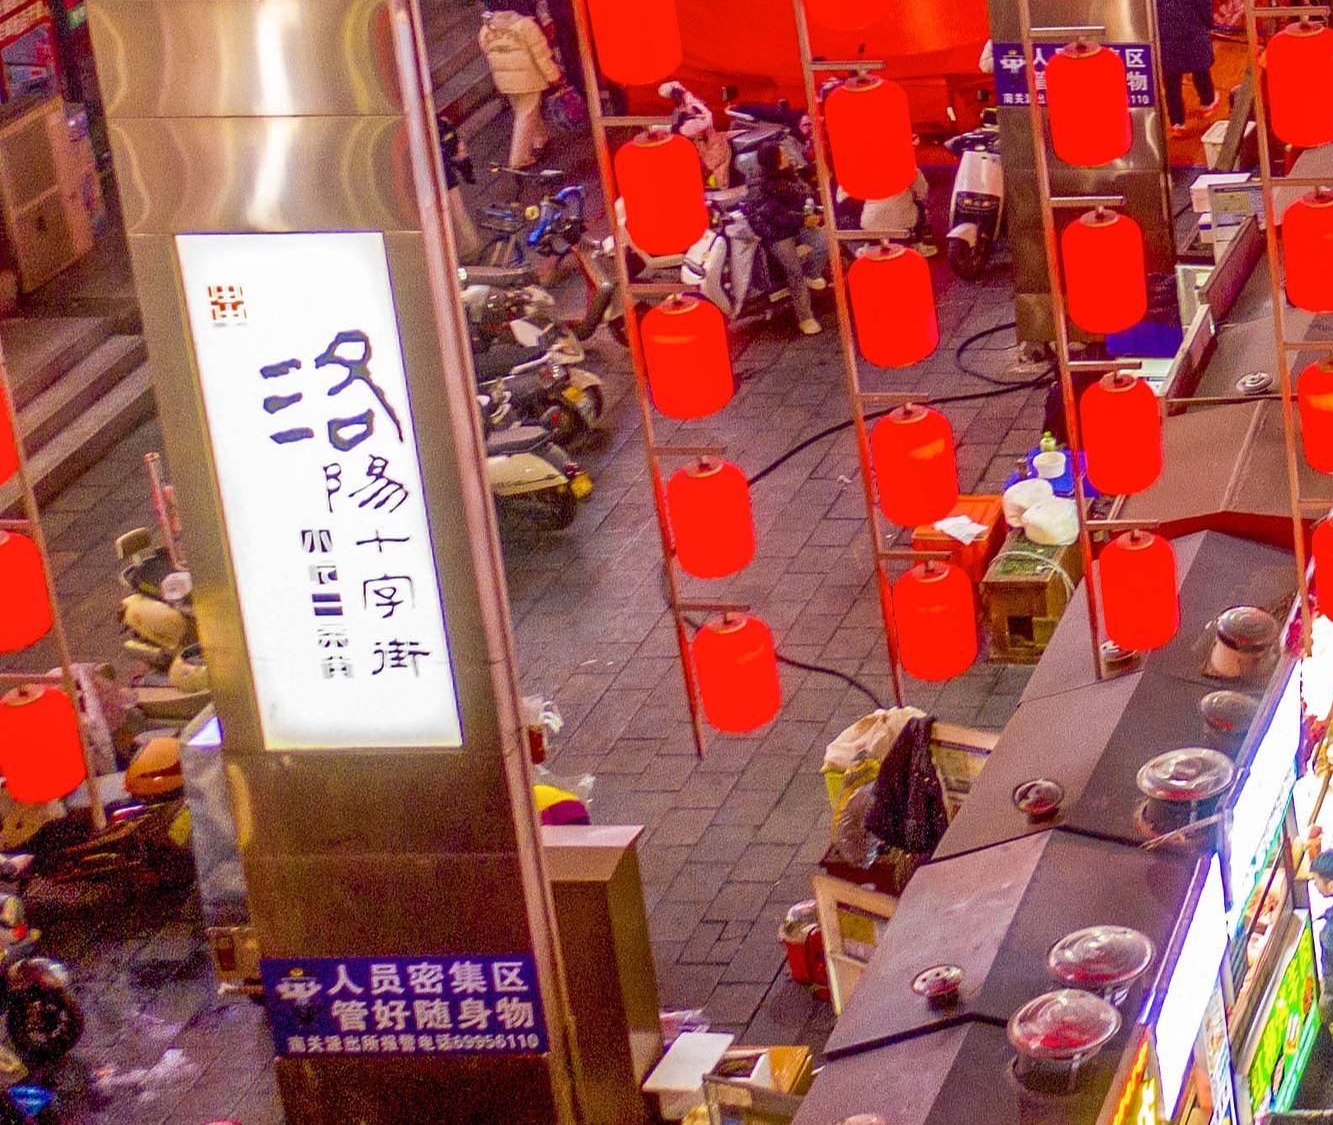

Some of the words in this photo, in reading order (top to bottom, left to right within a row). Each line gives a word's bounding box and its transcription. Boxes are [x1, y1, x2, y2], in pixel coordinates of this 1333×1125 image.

[327, 961, 530, 995] 人员密集区
[331, 997, 535, 1031] 管好随身物
